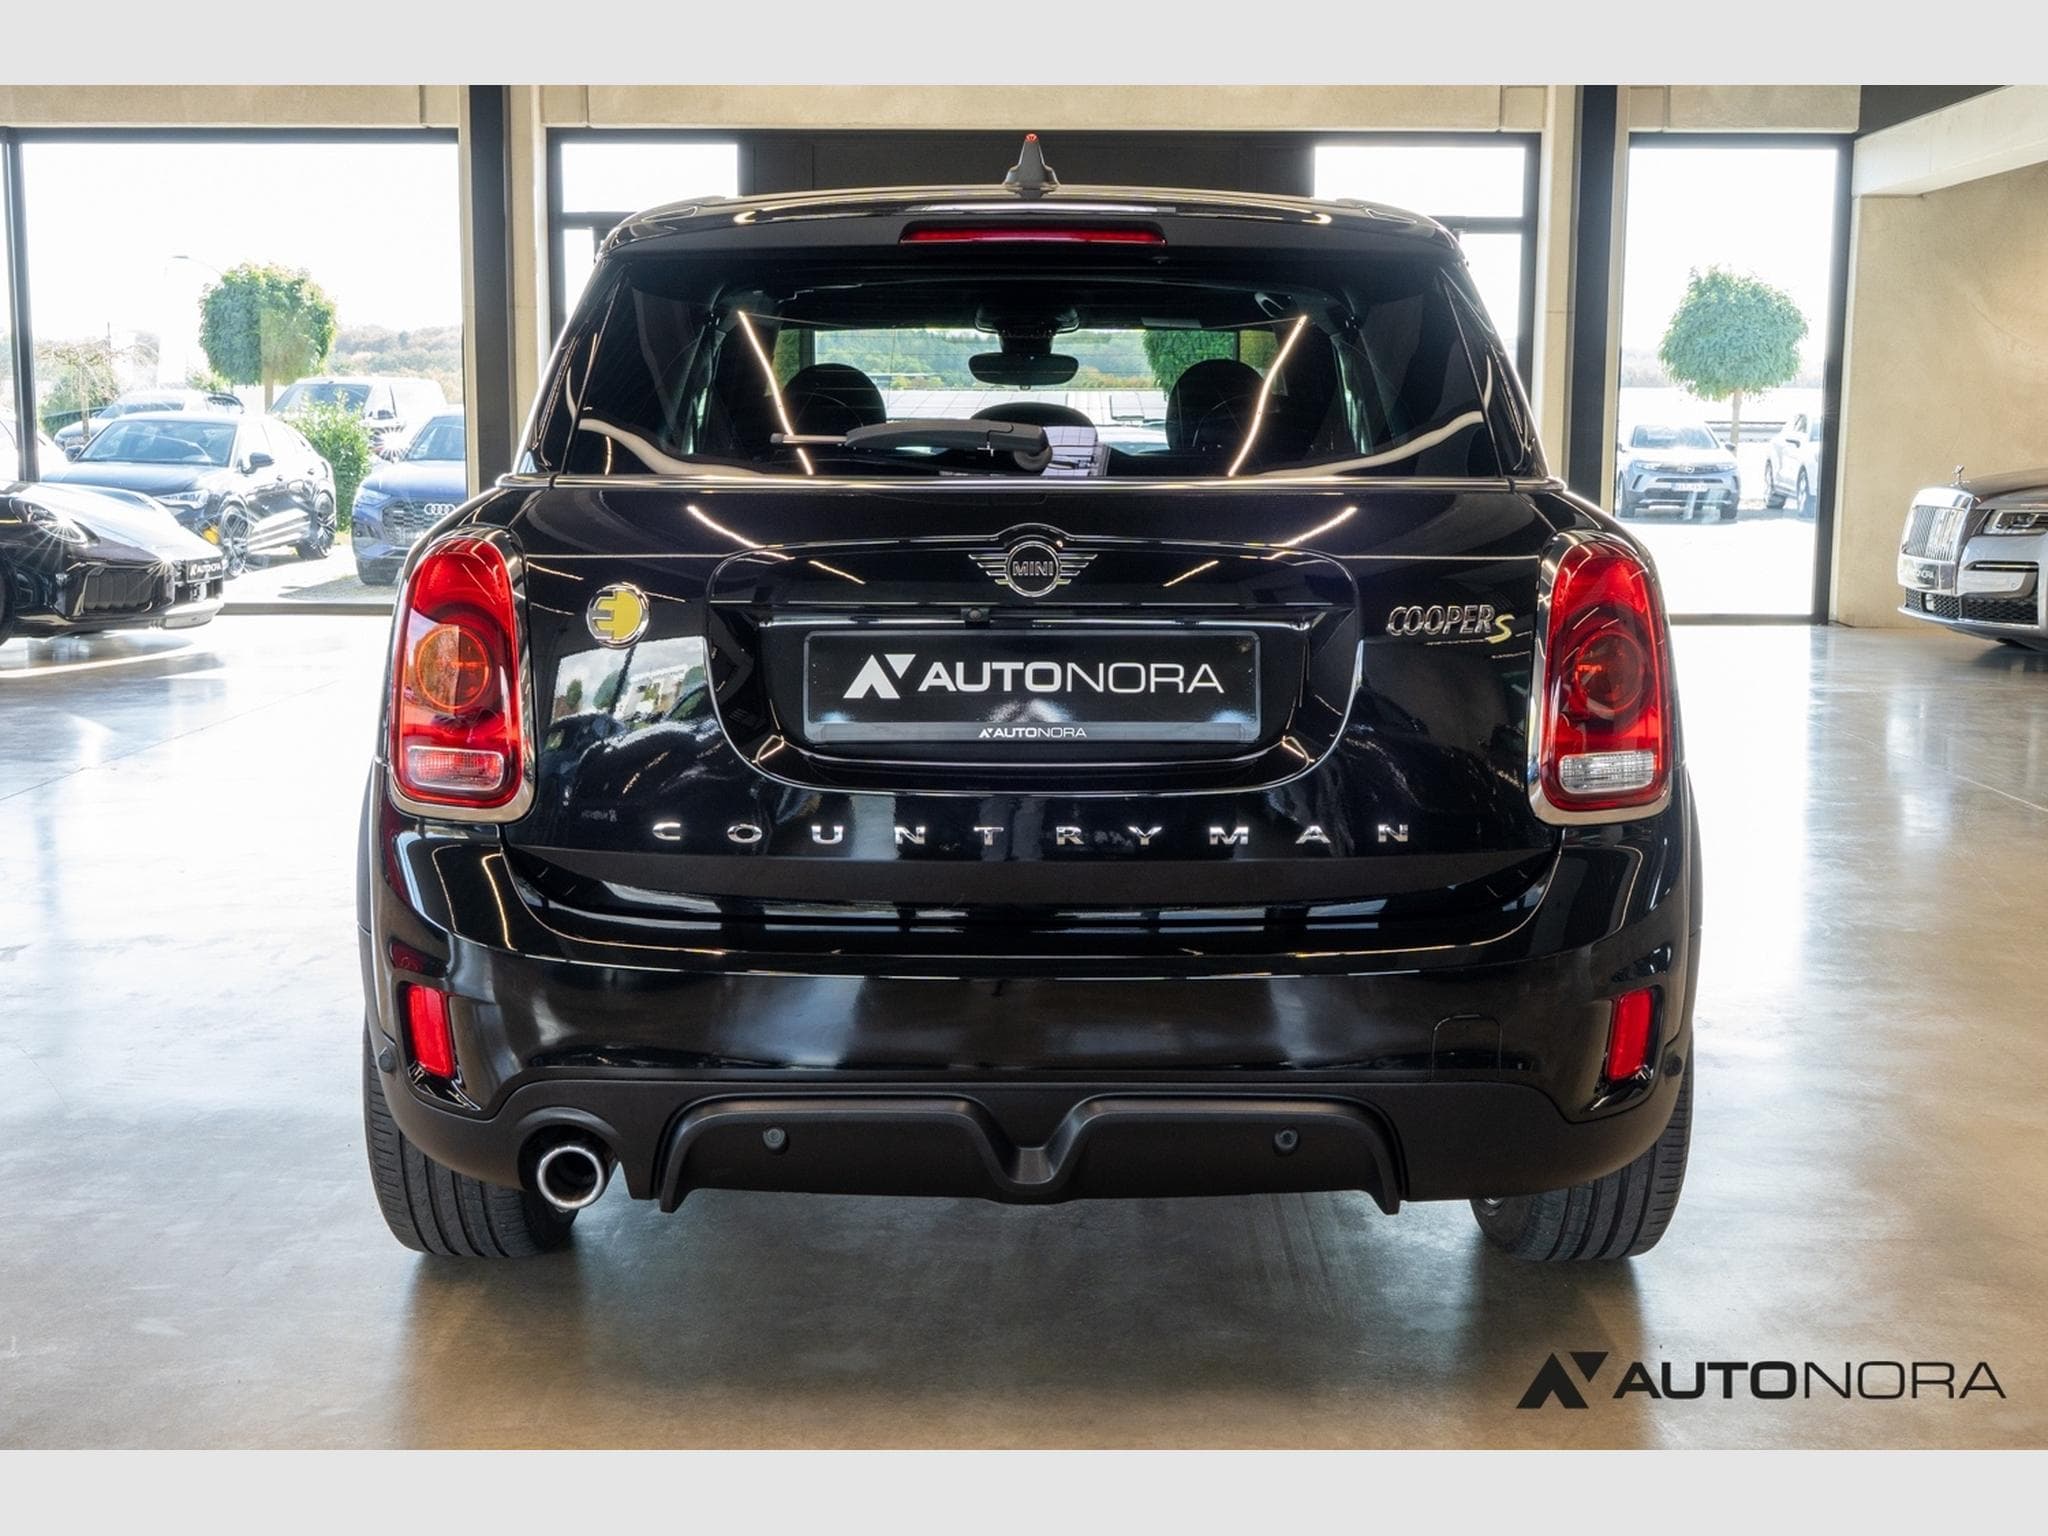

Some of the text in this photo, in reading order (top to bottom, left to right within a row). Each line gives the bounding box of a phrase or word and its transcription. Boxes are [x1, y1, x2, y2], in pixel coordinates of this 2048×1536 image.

[1012, 560, 1054, 576] MINI
[1386, 604, 1516, 644] COOPER S
[917, 661, 1225, 694] AUTONORA
[992, 727, 1088, 739] AUTONORA
[652, 821, 1409, 846] COUNTRYMAN
